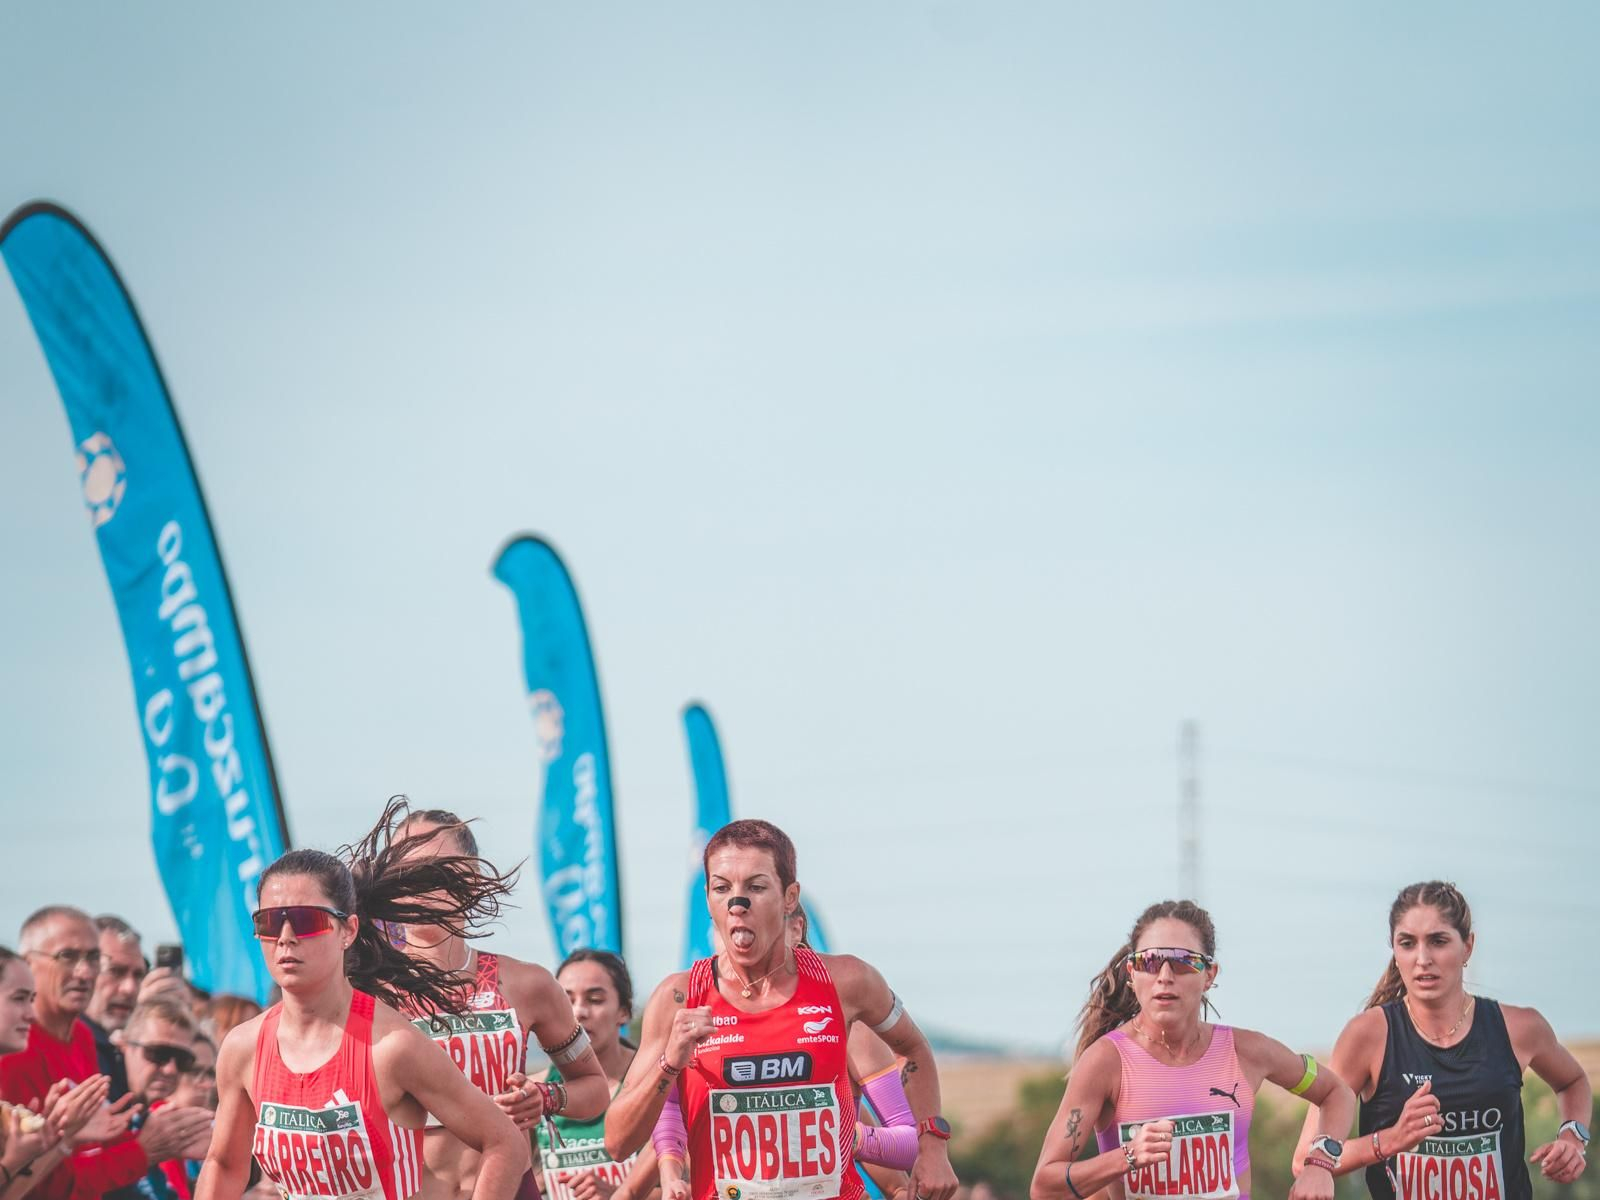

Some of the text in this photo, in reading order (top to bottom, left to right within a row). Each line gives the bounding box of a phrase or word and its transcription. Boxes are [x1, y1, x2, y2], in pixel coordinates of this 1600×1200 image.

[712, 1015, 738, 1027] lbao
[436, 1030, 518, 1096] RANO
[760, 1056, 805, 1080] BM
[746, 1092, 806, 1109] ITÁLICA
[279, 1110, 326, 1129] ITÁLICA
[1172, 1120, 1204, 1133] LICA
[1441, 1107, 1502, 1132] SHO
[713, 1108, 837, 1181] ROBLES
[254, 1127, 373, 1197] BARREIRO
